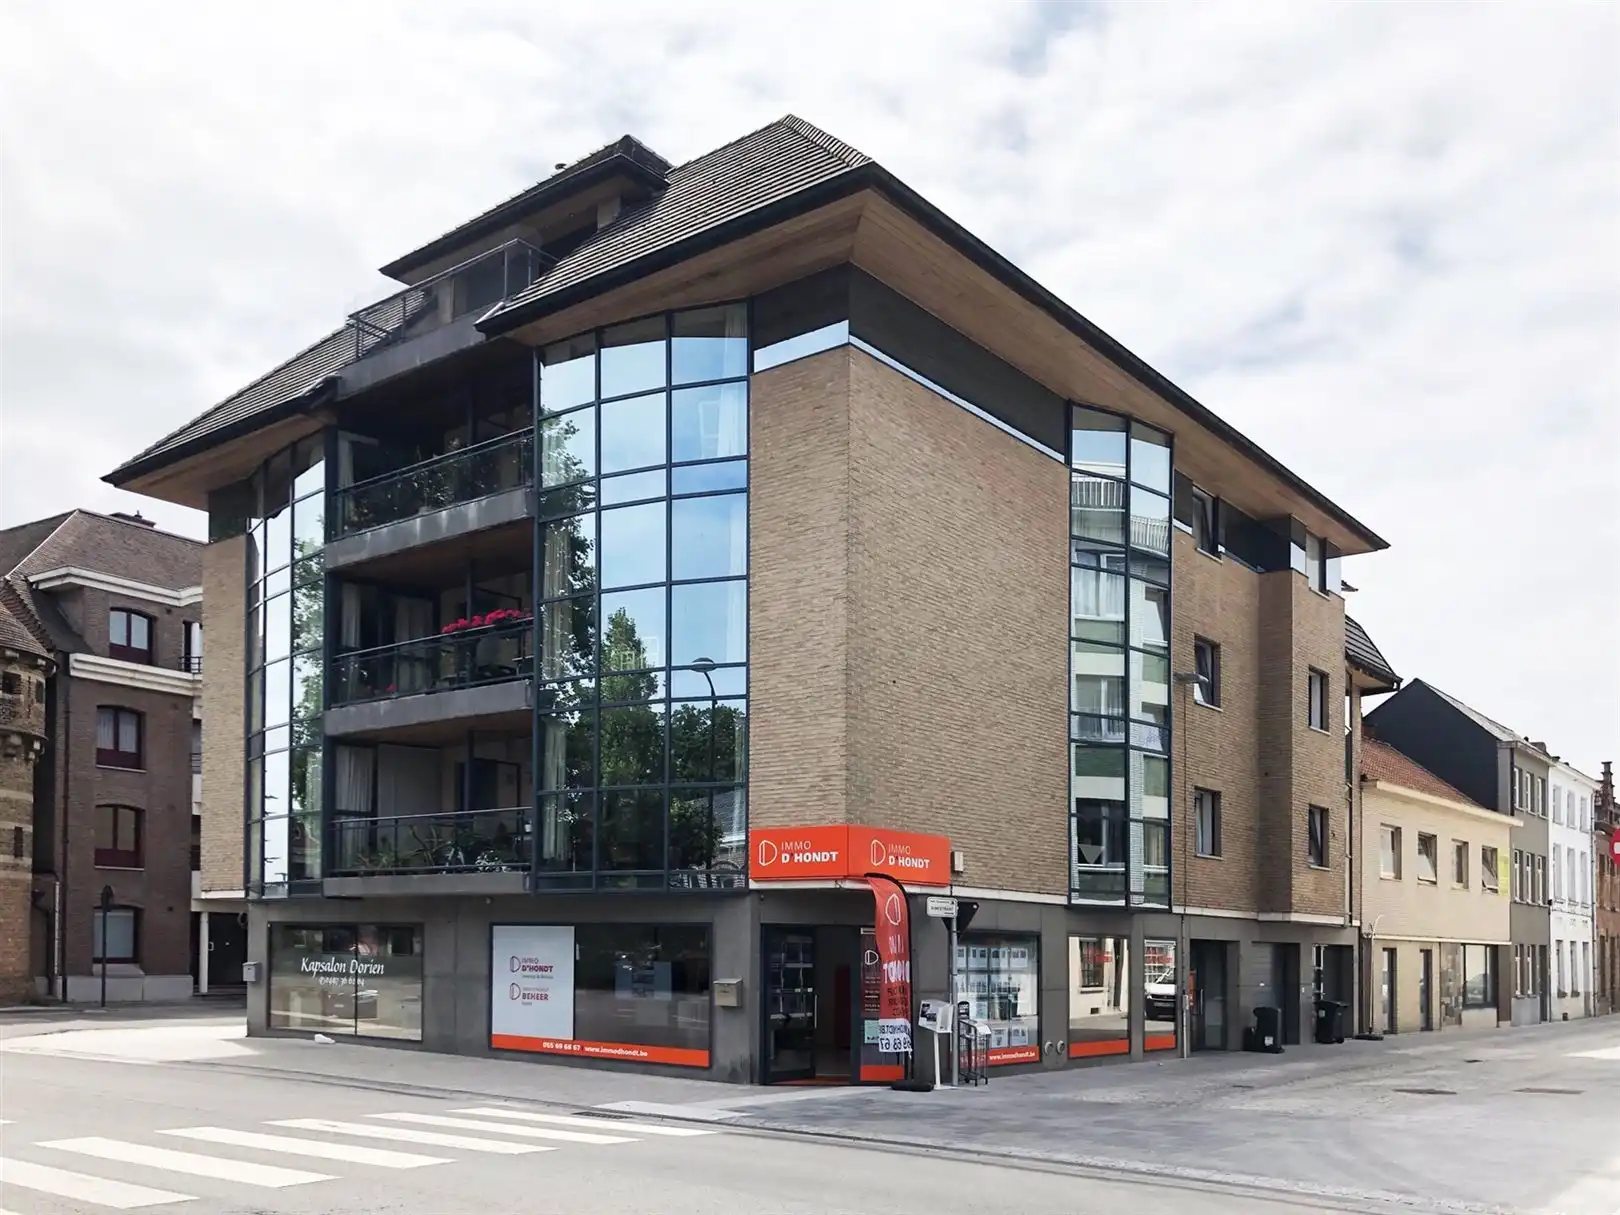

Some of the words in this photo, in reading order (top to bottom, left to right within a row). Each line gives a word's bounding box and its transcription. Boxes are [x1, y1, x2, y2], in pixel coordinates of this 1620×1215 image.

[781, 840, 811, 850] IMMO
[888, 843, 911, 854] IMMO
[781, 851, 838, 864] D'HONDT
[888, 855, 930, 868] D'HONDT
[301, 957, 346, 978] Kapsalon
[349, 959, 385, 975] Dorien
[521, 965, 554, 973] D'HONDT
[522, 993, 549, 1001] BEHEER
[584, 1045, 648, 1057] www.immodhondt.be
